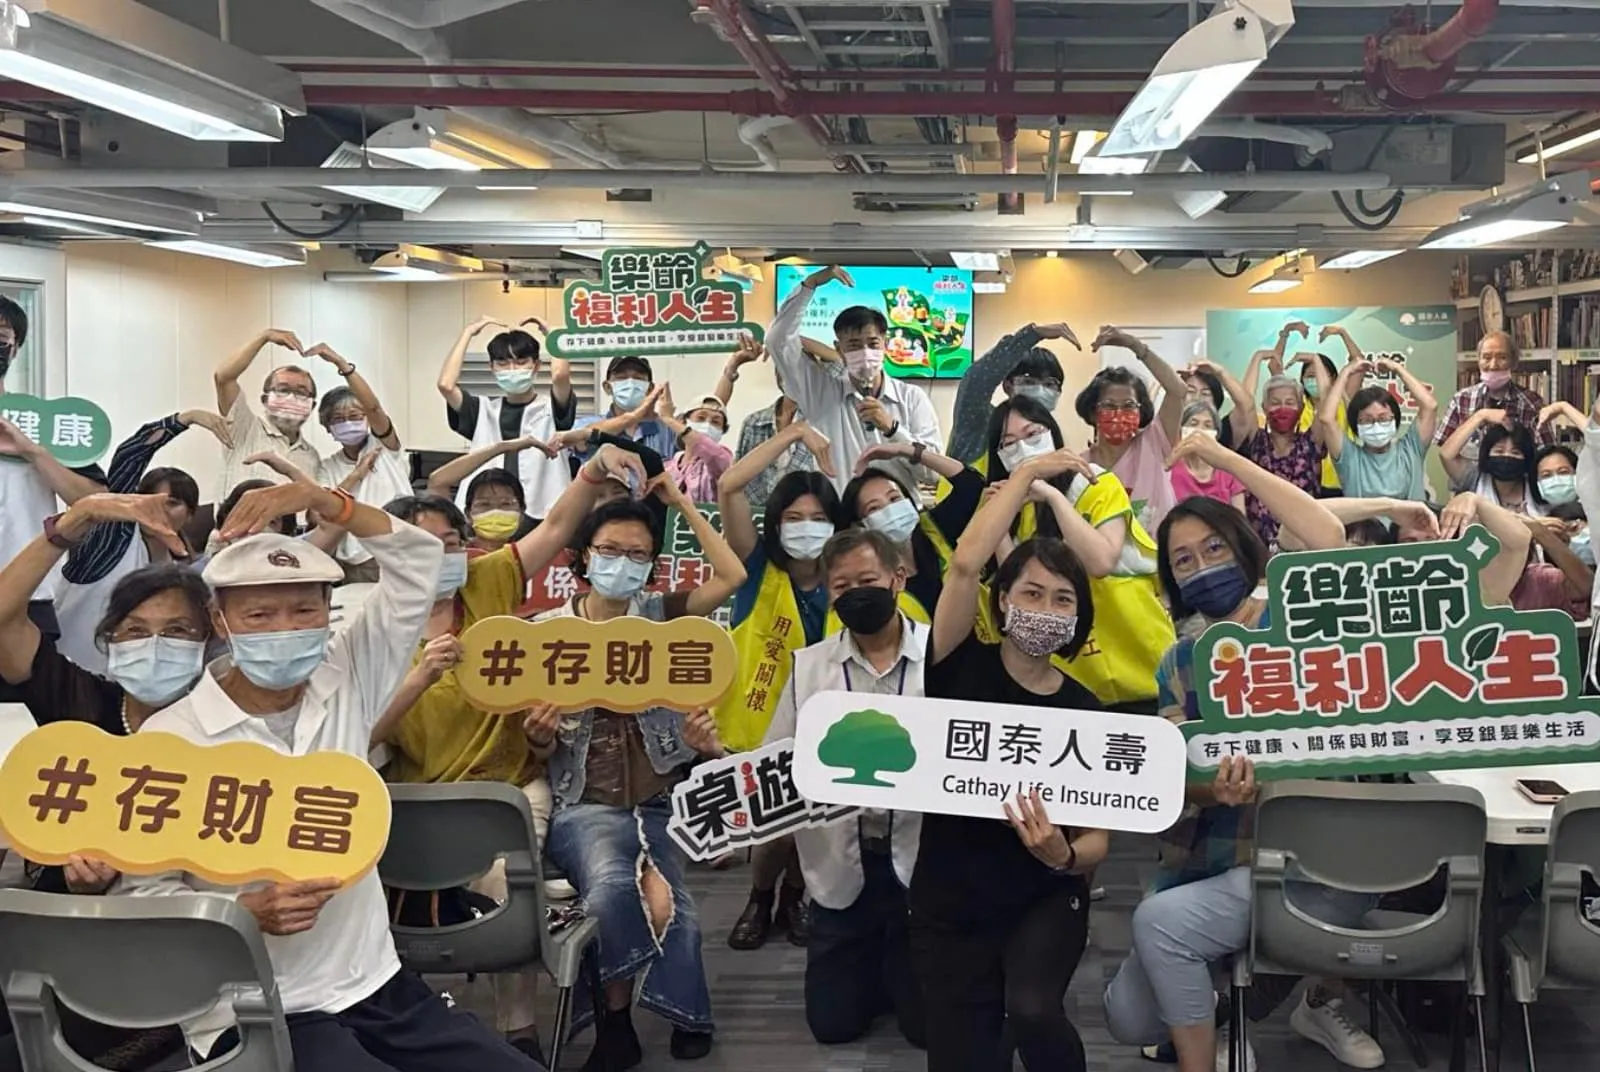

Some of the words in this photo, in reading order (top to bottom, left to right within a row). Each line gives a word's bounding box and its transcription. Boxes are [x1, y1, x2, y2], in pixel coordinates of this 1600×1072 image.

[609, 253, 696, 291] 樂齡
[1283, 557, 1469, 641] 樂齡
[480, 640, 714, 685] #存財富
[747, 616, 792, 712] 用愛關懷
[946, 719, 1147, 775] 國泰人壽
[29, 756, 360, 854] #存財富
[942, 774, 1011, 802] Cathay
[1018, 781, 1053, 802] Life
[1061, 785, 1159, 812] Insurance
